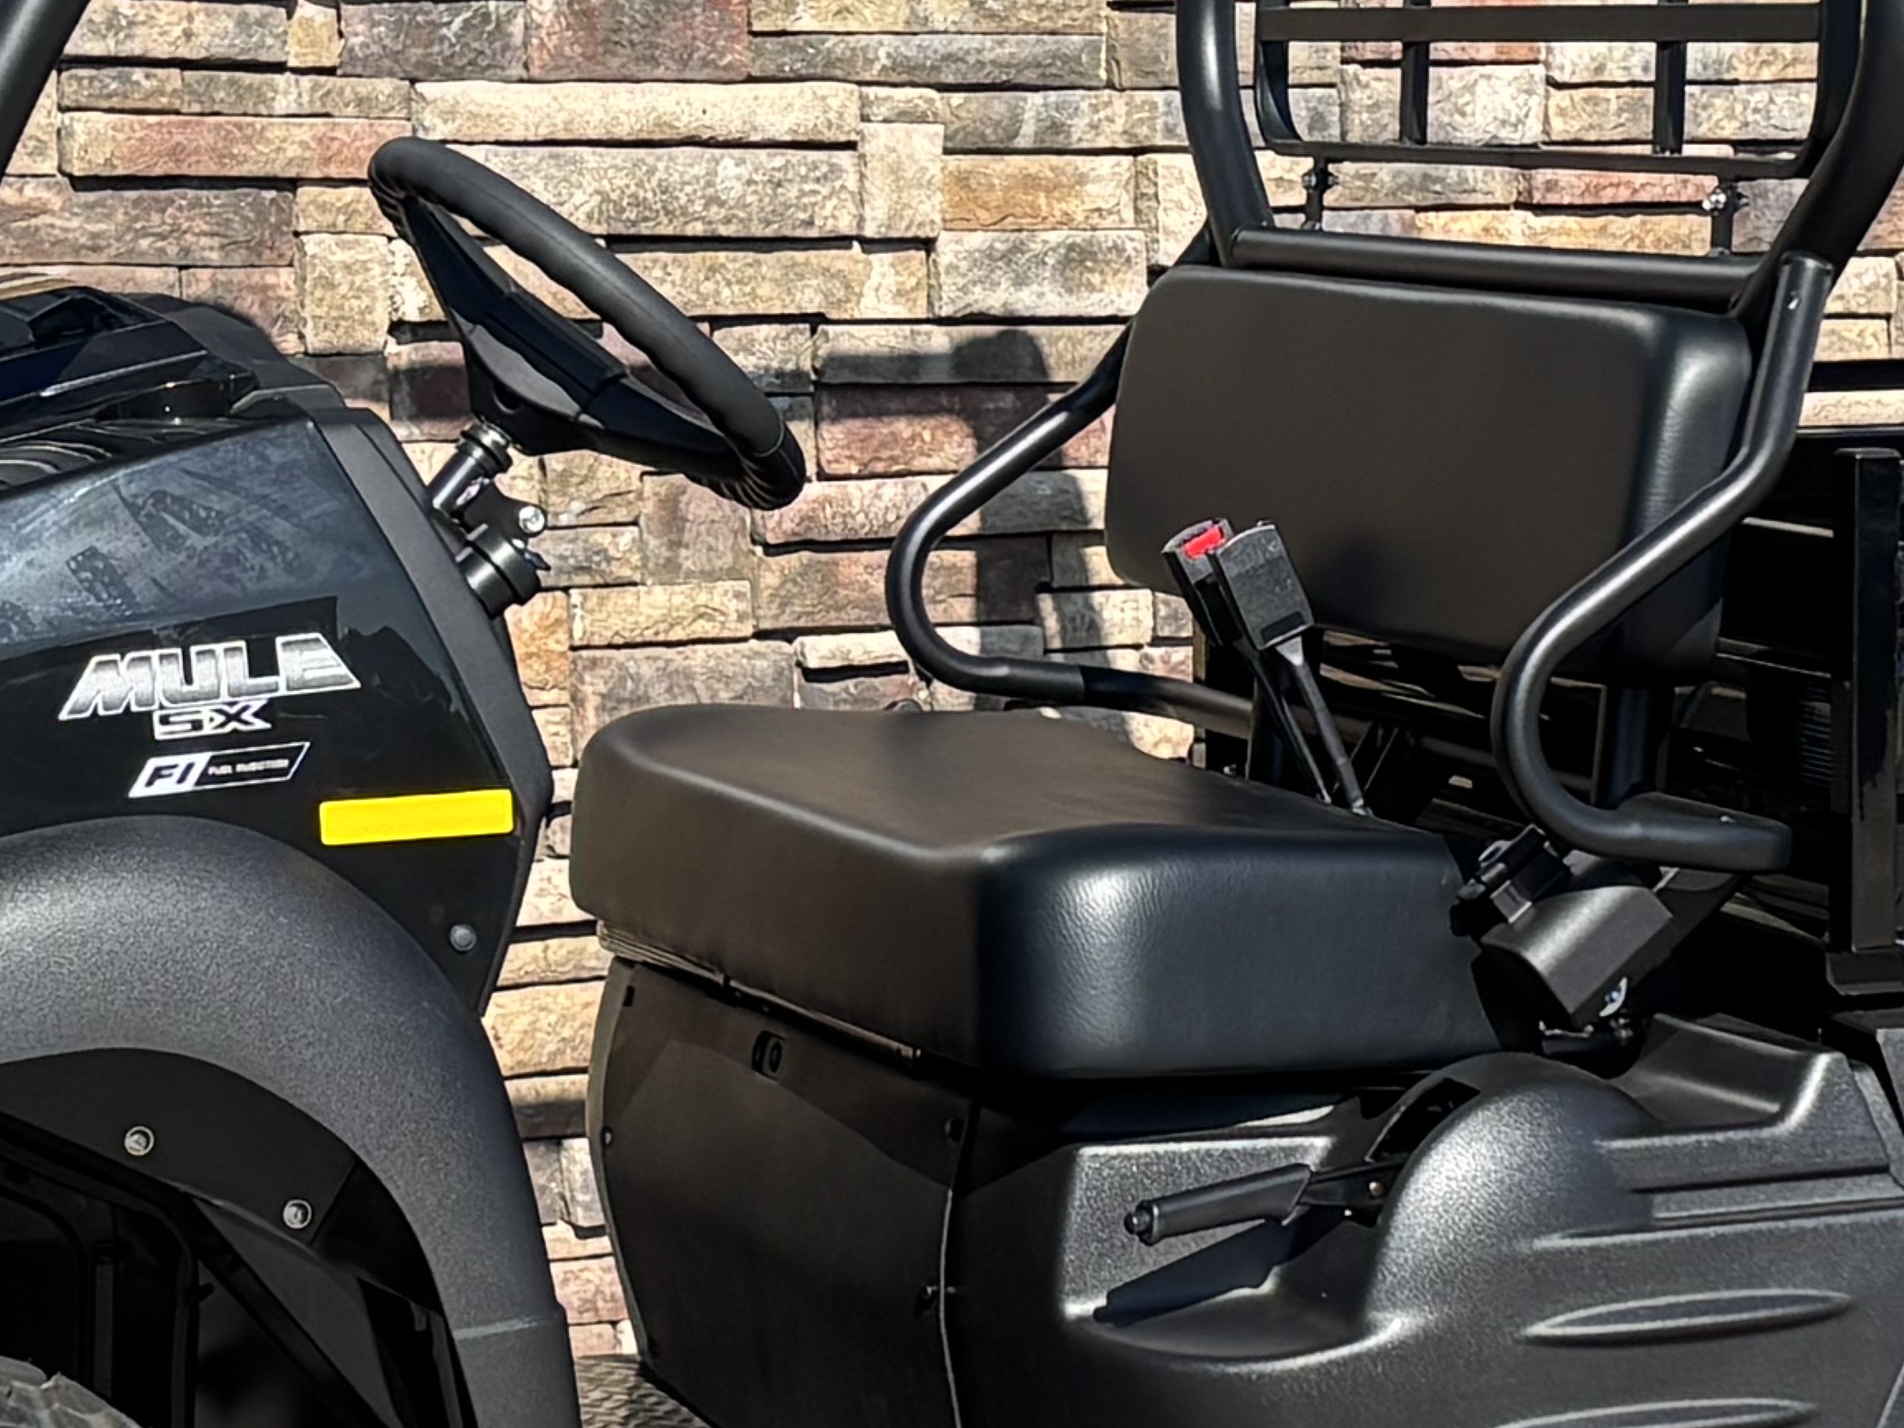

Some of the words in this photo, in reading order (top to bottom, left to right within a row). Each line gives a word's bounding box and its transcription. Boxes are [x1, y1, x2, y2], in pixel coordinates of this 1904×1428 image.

[58, 632, 362, 721] MULE
[152, 698, 273, 741] SX
[144, 761, 196, 788] FI
